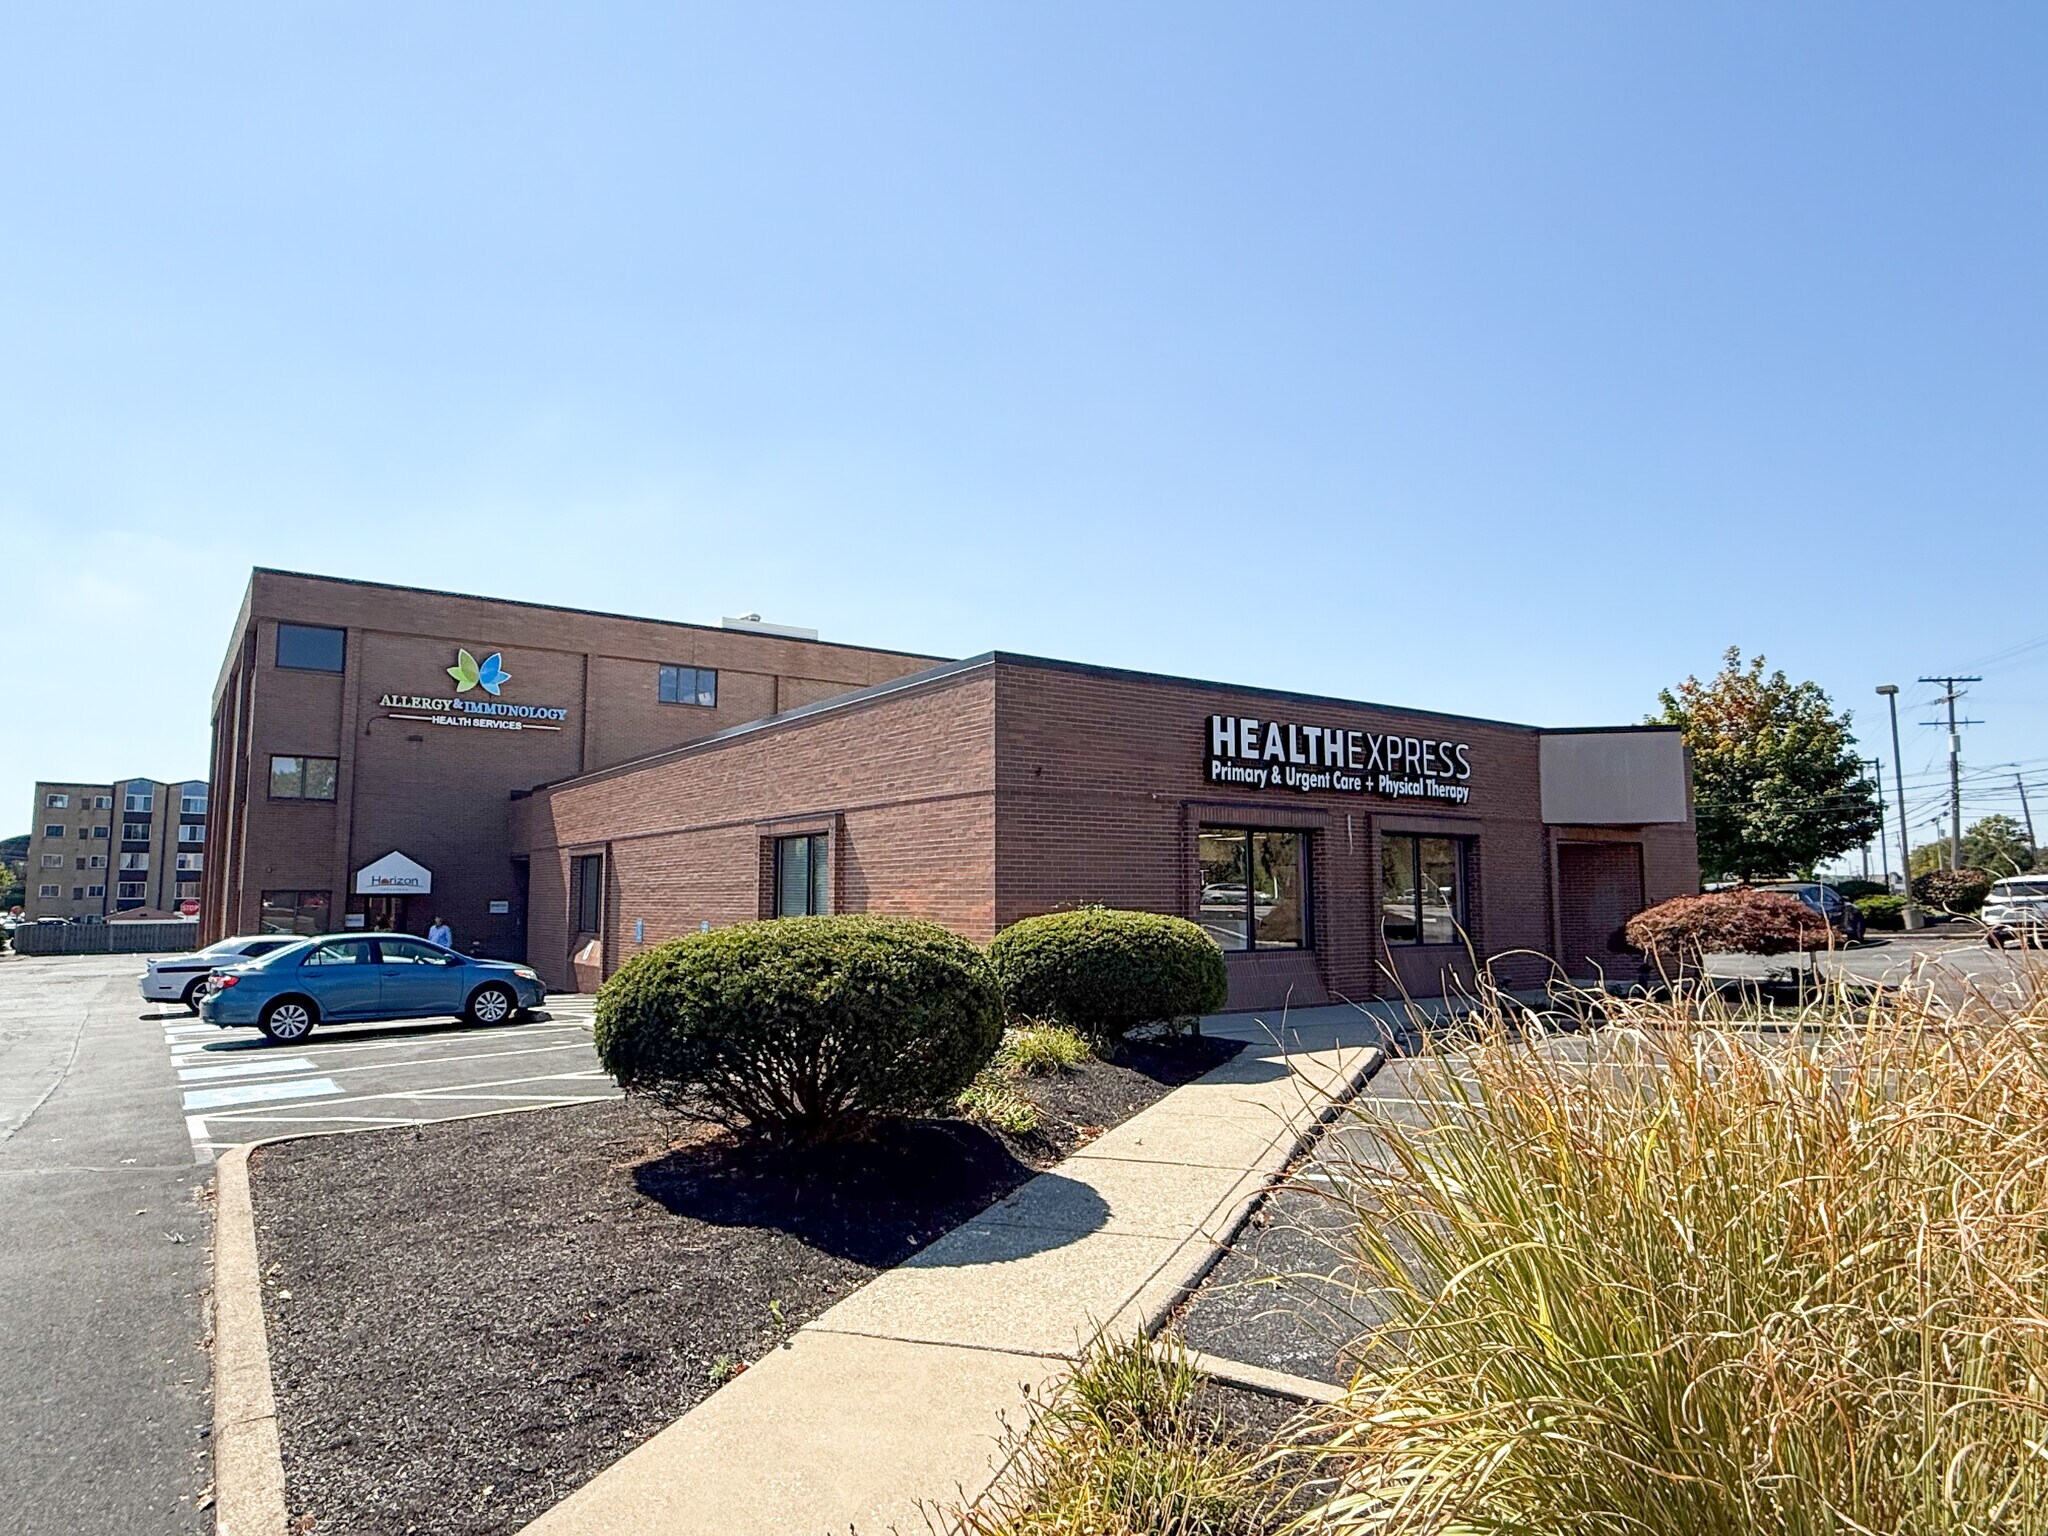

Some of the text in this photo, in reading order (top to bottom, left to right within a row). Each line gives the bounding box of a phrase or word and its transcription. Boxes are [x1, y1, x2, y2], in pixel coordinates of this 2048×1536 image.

[431, 715, 522, 730] HEALTH SERVICES
[1212, 760, 1267, 788] Primary
[1271, 765, 1282, 784] &
[1286, 766, 1330, 791] Urgent
[1333, 770, 1361, 790] Care
[1379, 774, 1423, 797] Physical
[1426, 778, 1469, 803] Therapy
[372, 875, 419, 886] Horizon
[181, 904, 199, 912] STOP
